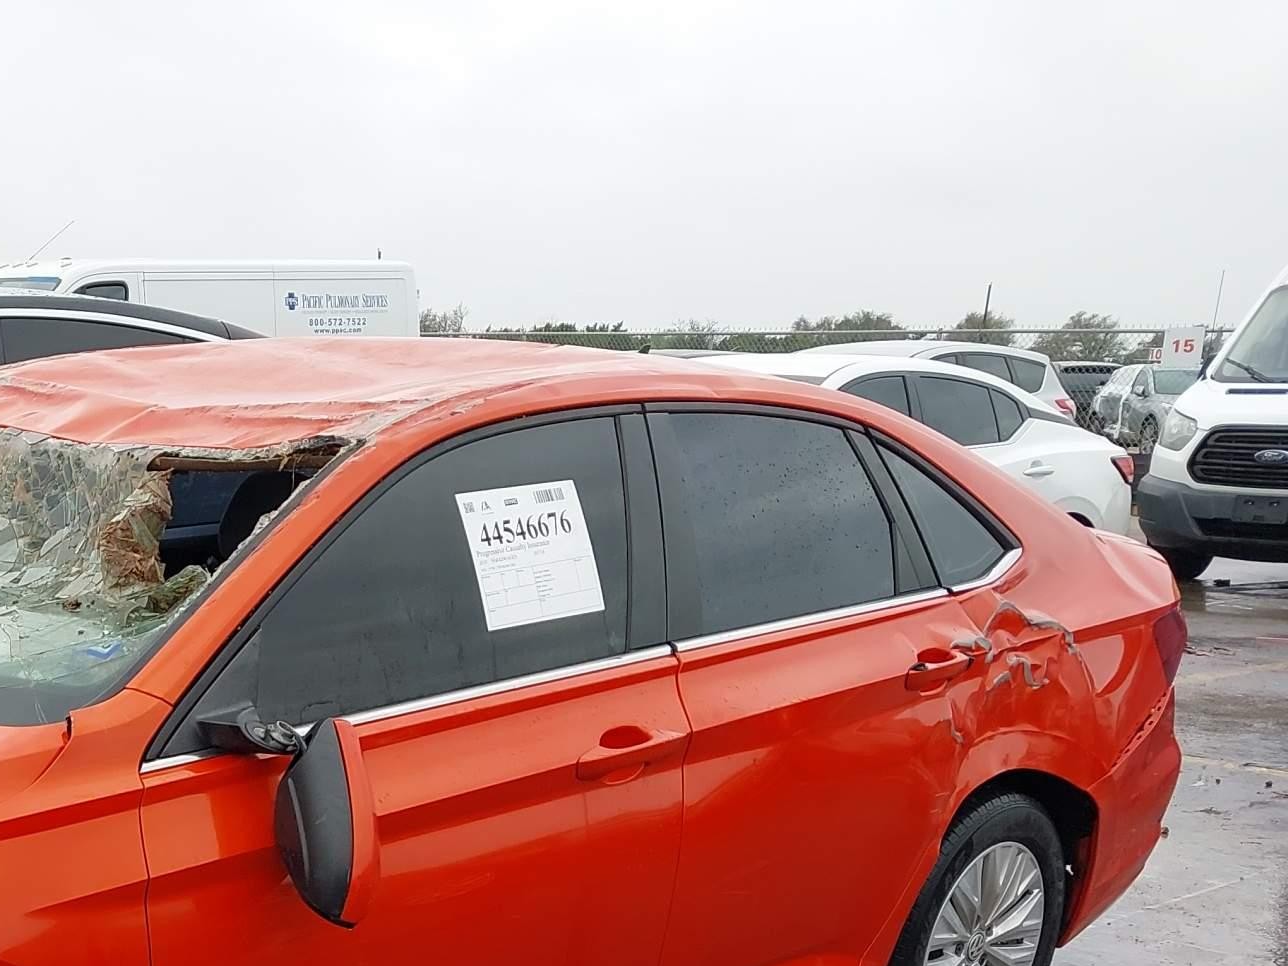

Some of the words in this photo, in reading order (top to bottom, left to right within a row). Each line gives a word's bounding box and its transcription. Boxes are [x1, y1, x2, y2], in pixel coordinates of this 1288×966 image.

[309, 318, 367, 327] 800-572-7522
[1172, 339, 1195, 353] 15
[480, 509, 572, 547] 44546676
